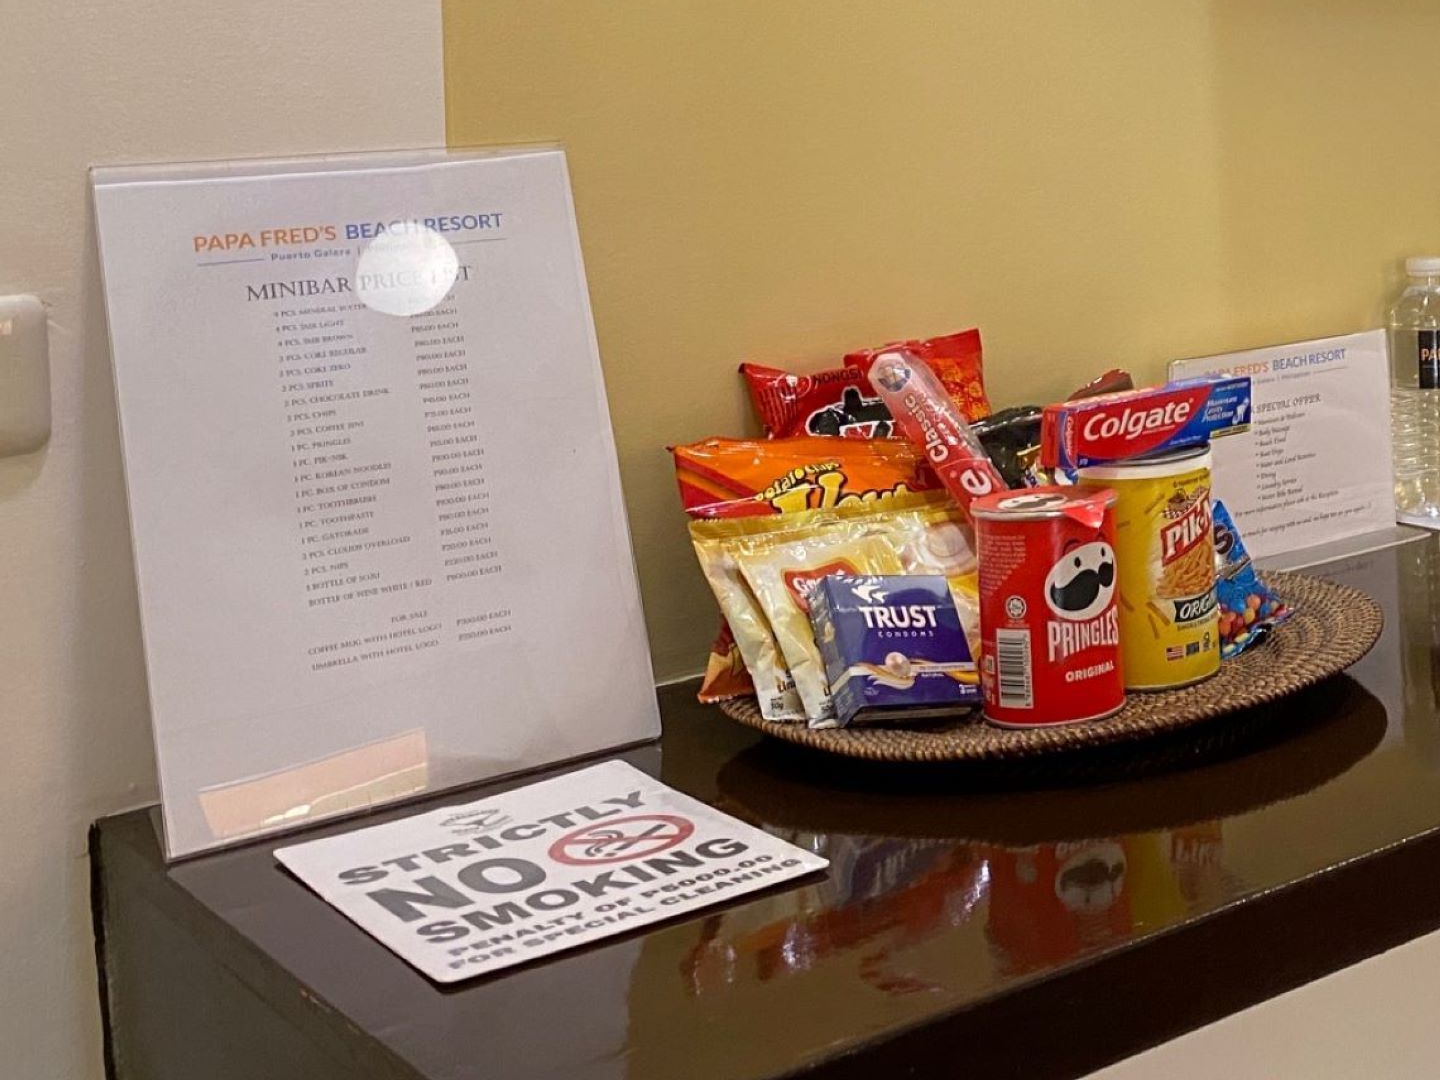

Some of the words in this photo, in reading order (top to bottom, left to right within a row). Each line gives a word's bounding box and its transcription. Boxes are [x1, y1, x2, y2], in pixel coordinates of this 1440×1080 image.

[193, 233, 255, 252] PAPA
[260, 225, 337, 247] FRED'S
[423, 213, 504, 232] RESORT
[246, 275, 352, 302] MINIBAR
[812, 369, 860, 384] NONGS
[1273, 356, 1308, 371] BEACH
[1309, 348, 1346, 366] RESORT
[1083, 401, 1190, 441] Colgate
[857, 604, 938, 629] TRUST
[1047, 604, 1119, 663] PRINGLES
[1065, 660, 1115, 683] ORIGINAL
[338, 790, 645, 885] STRICTLY
[365, 857, 547, 922] NO
[416, 838, 749, 943] SMOKING
[448, 945, 513, 970] FOR
[522, 906, 656, 948] SPECIAL
[660, 858, 802, 906] CLEANING
[448, 911, 584, 957] PENALTY
[594, 897, 632, 912] OF
